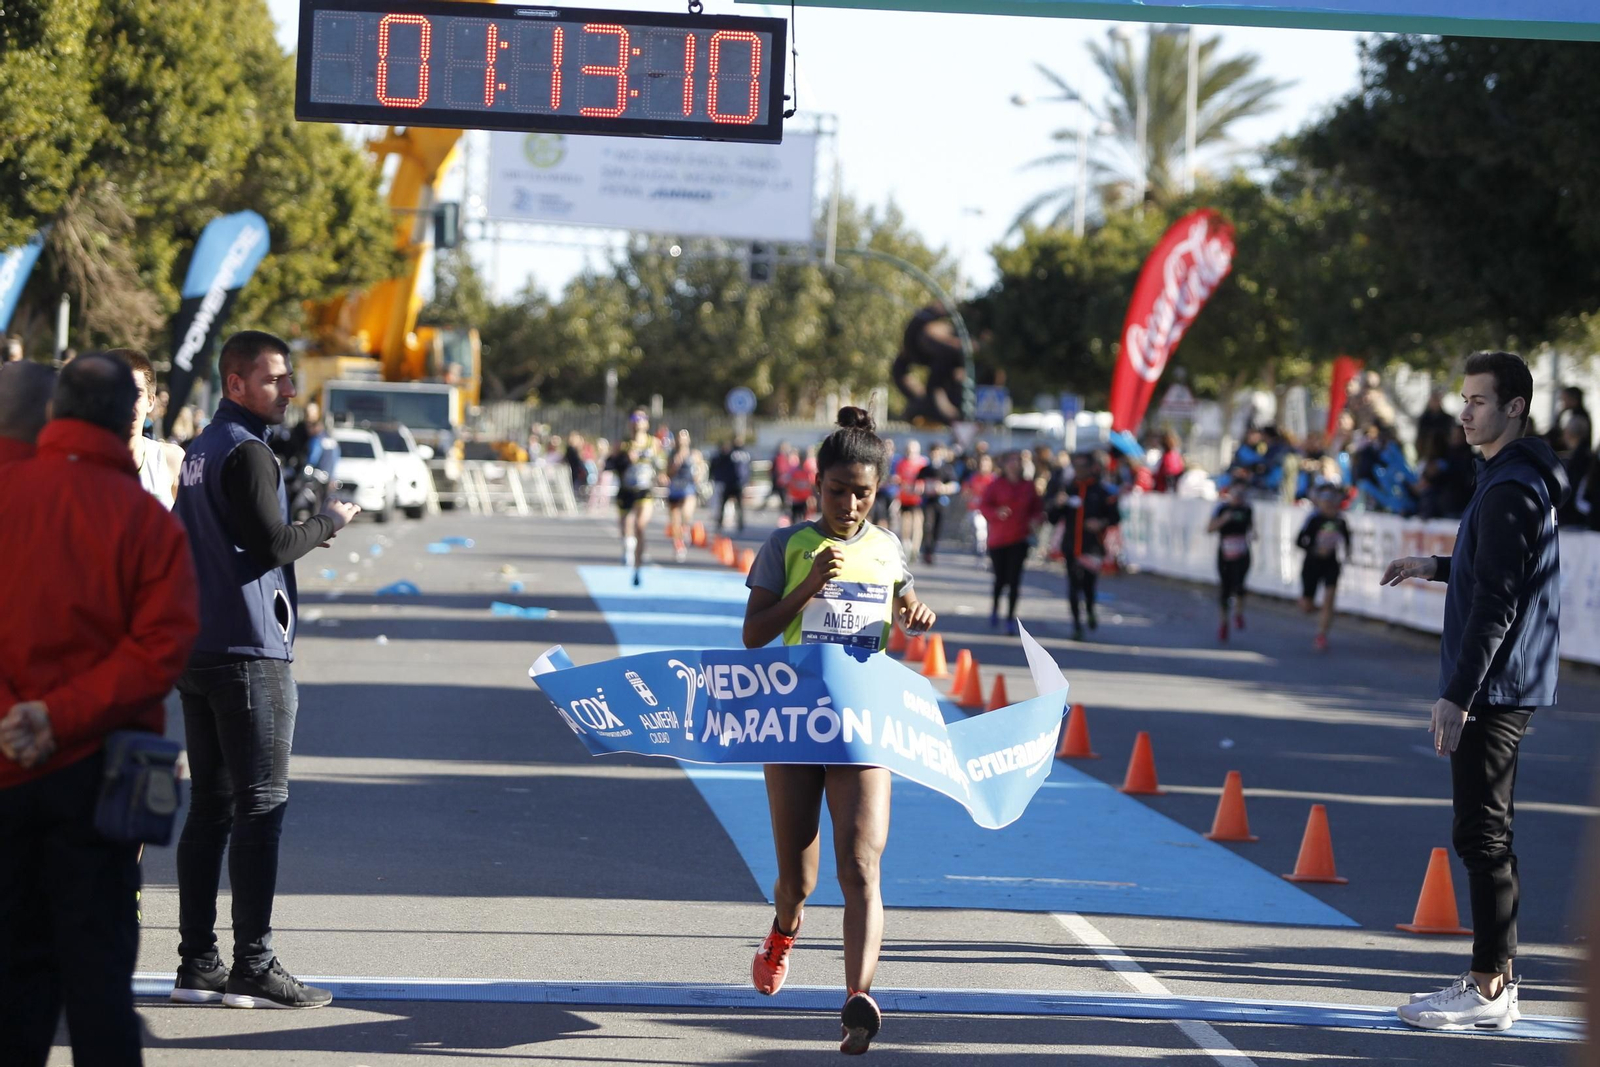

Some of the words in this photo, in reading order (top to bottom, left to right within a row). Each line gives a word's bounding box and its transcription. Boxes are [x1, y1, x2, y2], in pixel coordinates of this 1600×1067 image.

[376, 13, 762, 125] 01:13:10
[844, 602, 853, 613] 2
[700, 661, 799, 700] MEDIO
[639, 706, 680, 730] ALMERÍA
[701, 696, 873, 747] MARATÓN
[649, 731, 670, 744] CIUDAD
